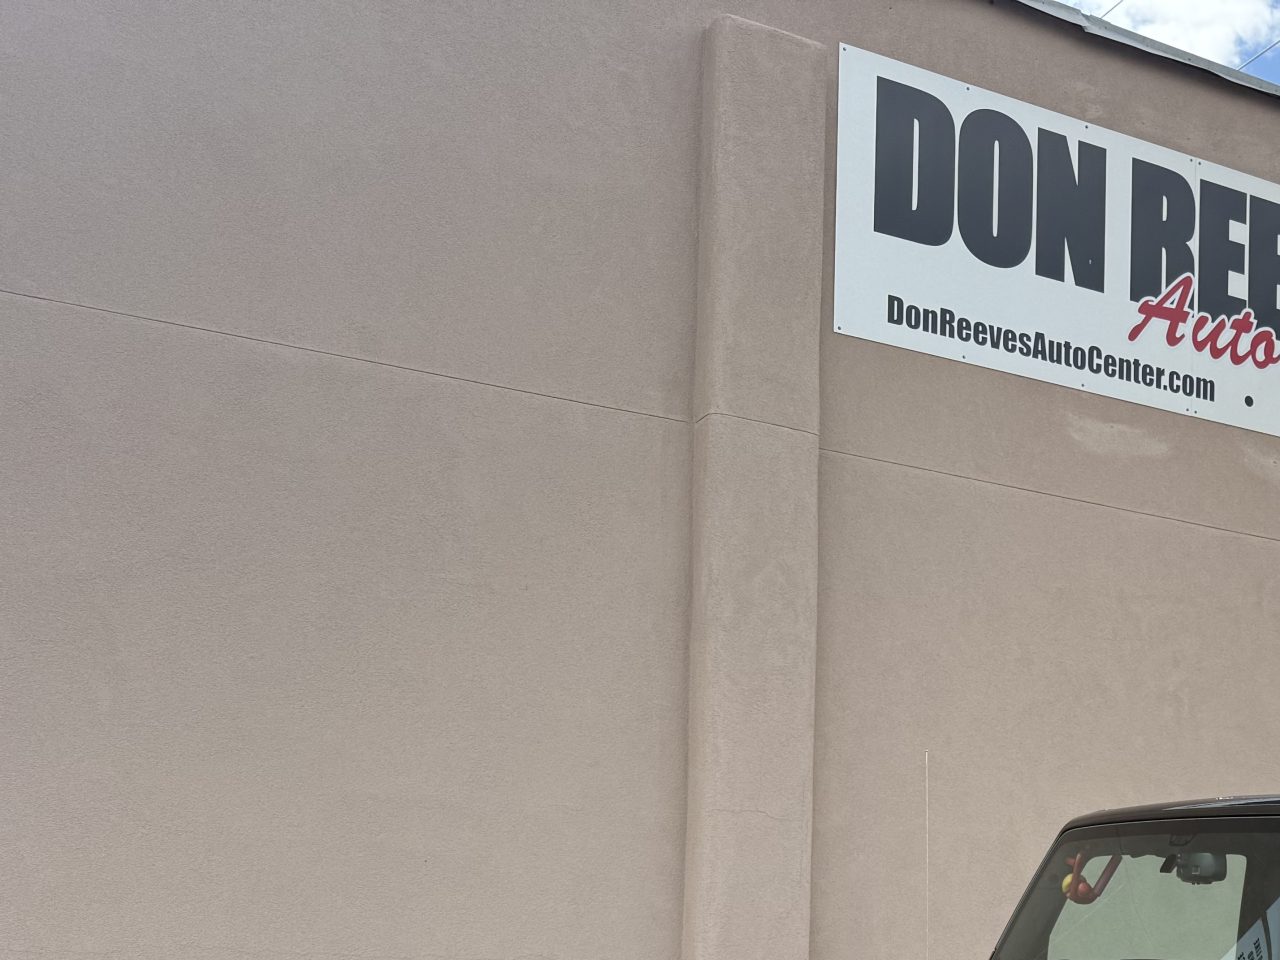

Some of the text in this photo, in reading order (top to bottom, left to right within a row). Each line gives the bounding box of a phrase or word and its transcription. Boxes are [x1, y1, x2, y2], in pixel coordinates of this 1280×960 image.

[873, 75, 1107, 293] DON
[886, 294, 1216, 402] DonReevesAutoCenter.com
[1128, 276, 1280, 369] Auto
